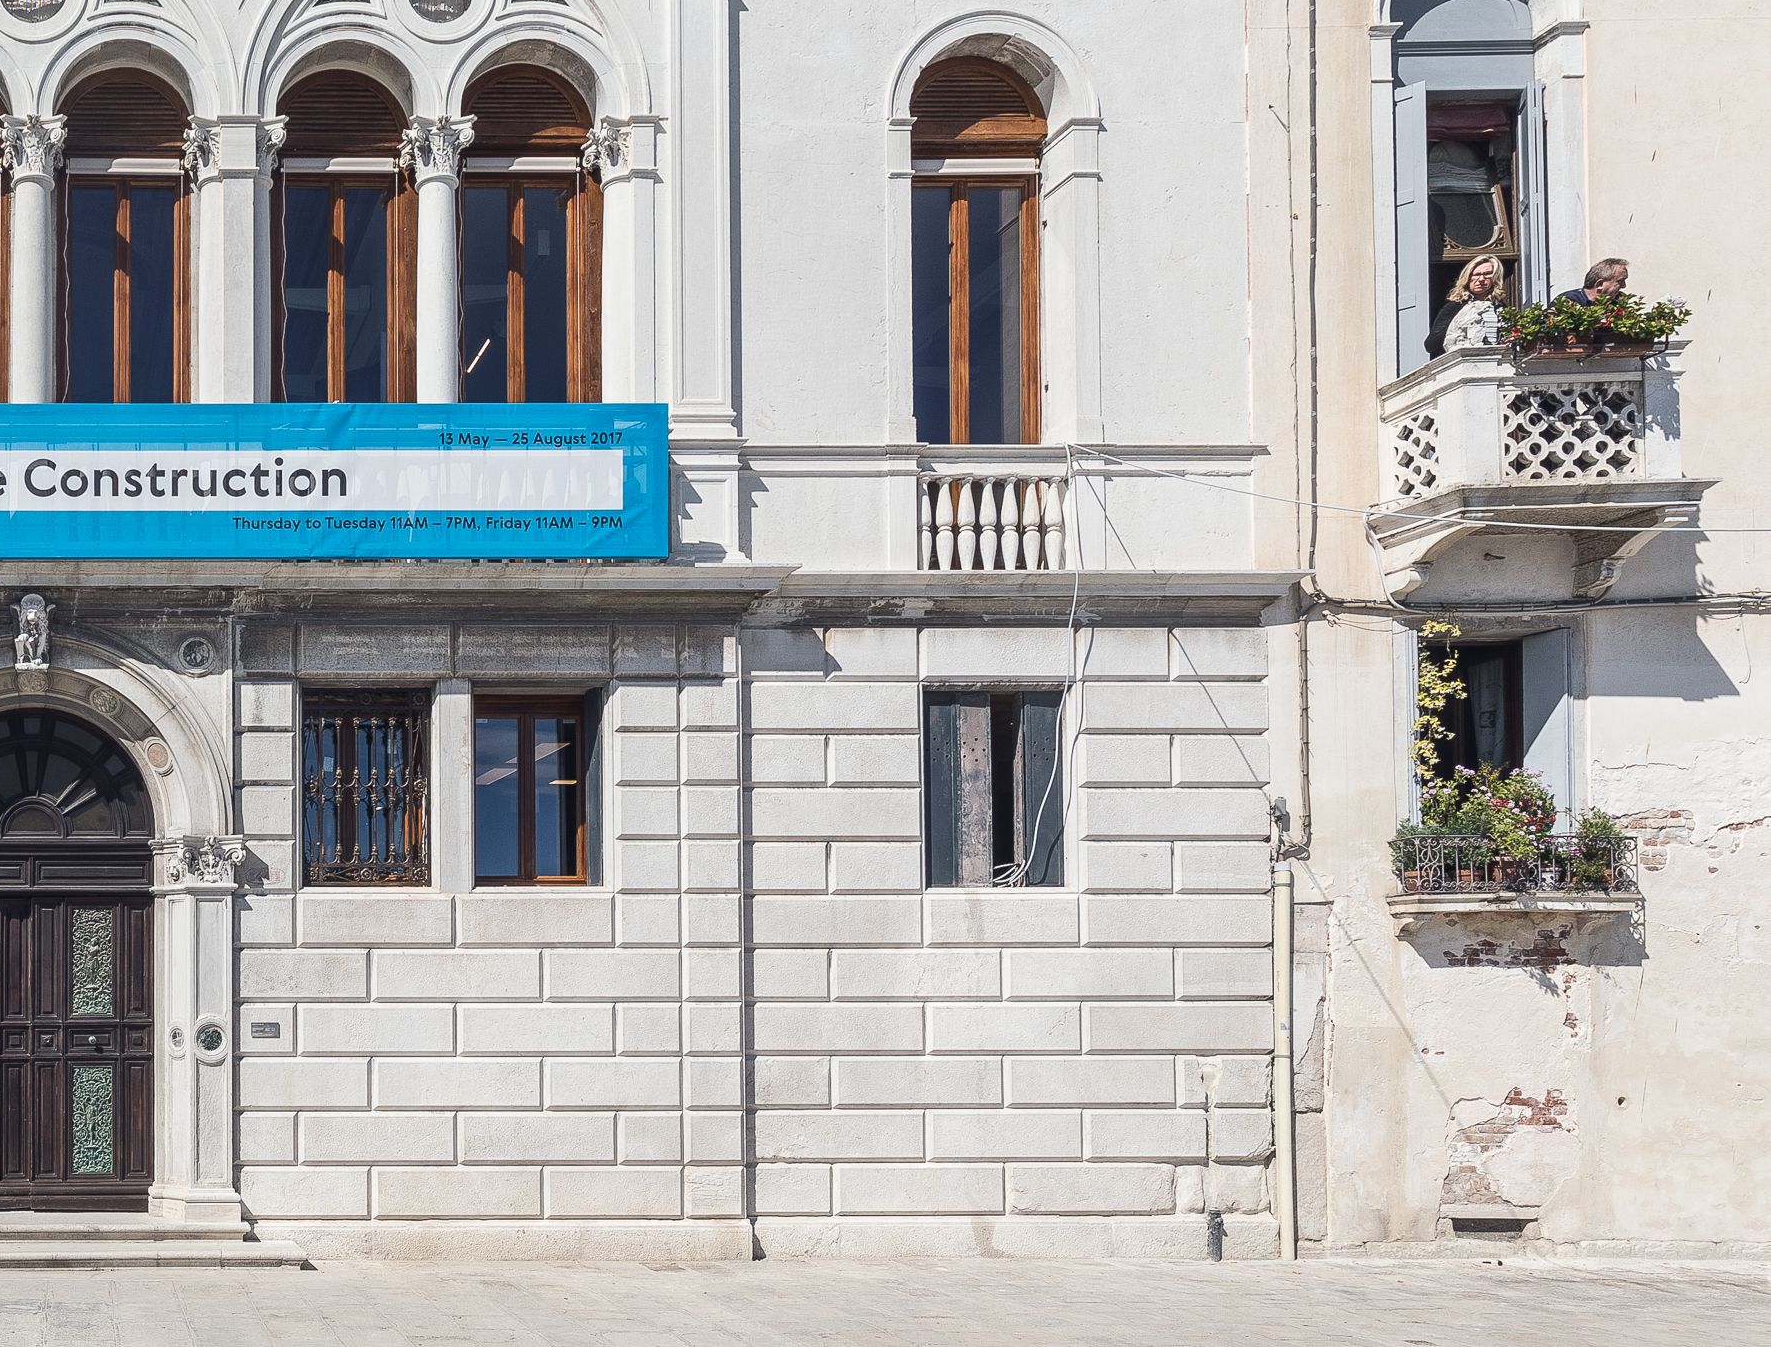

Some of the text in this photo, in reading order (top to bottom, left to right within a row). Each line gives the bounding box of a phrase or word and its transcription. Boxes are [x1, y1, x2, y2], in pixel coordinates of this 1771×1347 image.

[439, 432, 454, 445] 13
[458, 432, 490, 448] May
[512, 432, 529, 445] 25
[533, 432, 587, 448] August
[590, 432, 623, 445] 2017
[24, 457, 347, 498] Construction
[232, 516, 301, 533] Thursday
[305, 517, 322, 530] to
[324, 516, 386, 533] Tuesday
[390, 516, 428, 530] 11AM
[445, 516, 481, 531] 7PM,
[486, 516, 532, 532] Friday
[535, 516, 574, 529] 11AM
[591, 516, 623, 529] 9PM
